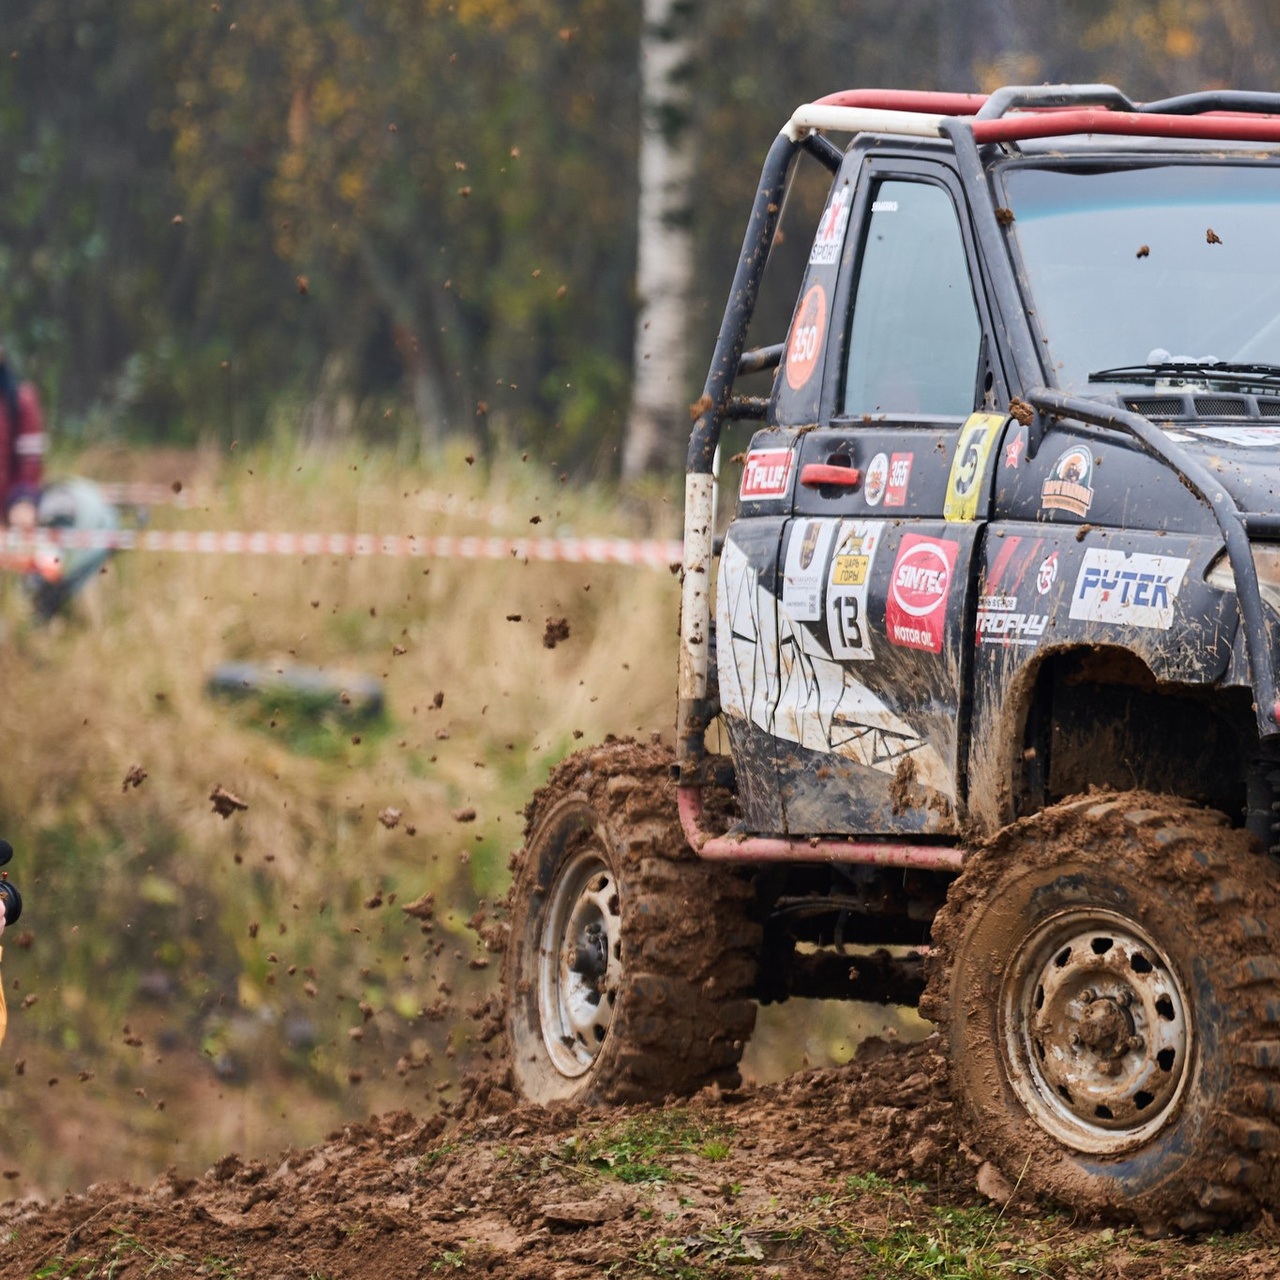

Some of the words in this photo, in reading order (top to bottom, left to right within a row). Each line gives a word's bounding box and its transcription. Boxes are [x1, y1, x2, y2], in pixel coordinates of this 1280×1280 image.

[811, 243, 839, 261] SPORT
[790, 325, 817, 363] 350
[889, 460, 909, 488] 355
[956, 428, 988, 495] 5
[839, 570, 860, 581] ГОРЫ
[843, 557, 860, 568] ЦАРЬ
[896, 564, 946, 594] SINTEC
[833, 596, 863, 649] 13
[976, 612, 1049, 636] TROPHY
[894, 626, 921, 644] MOTOR
[920, 630, 935, 647] OIL
